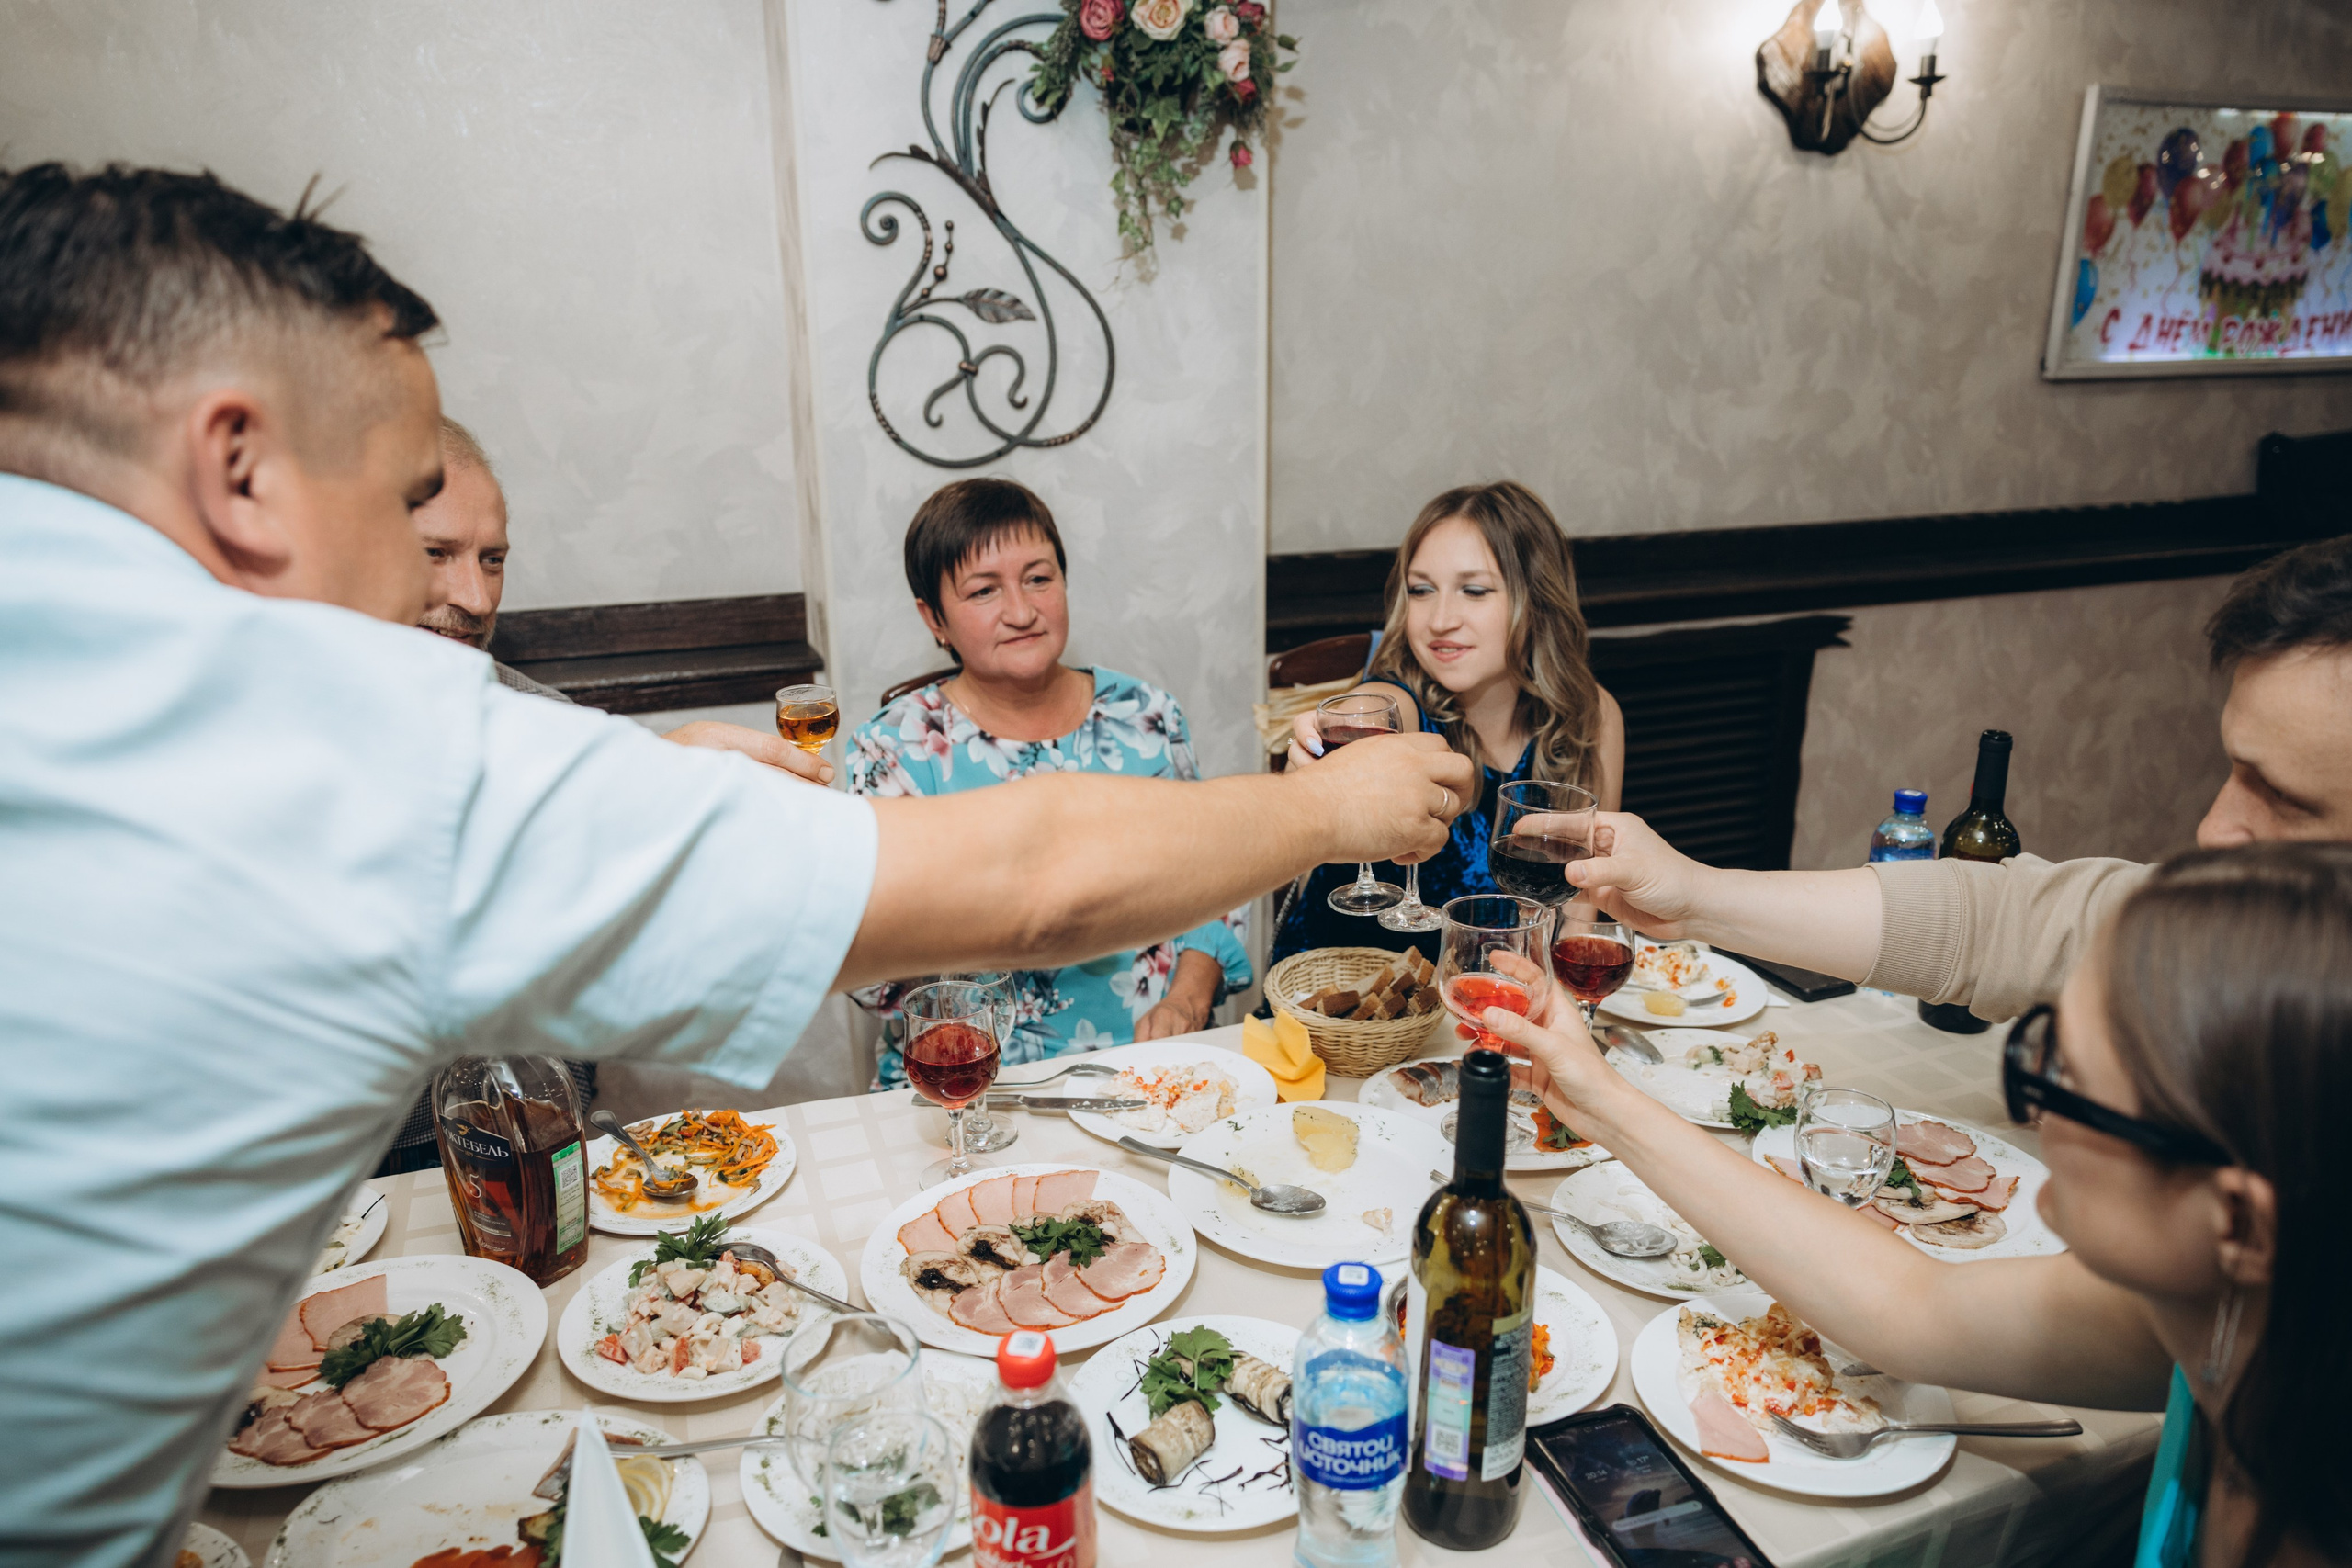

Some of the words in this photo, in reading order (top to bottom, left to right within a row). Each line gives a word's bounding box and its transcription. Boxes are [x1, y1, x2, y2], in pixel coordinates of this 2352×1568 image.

[2100, 307, 2121, 344] С
[441, 1123, 509, 1157] КОКТЕБЕЛЬ
[469, 1173, 481, 1199] 5
[1298, 1438, 1402, 1475] ИСТОЧНИК
[1307, 1430, 1394, 1459] СВЯТОЙ
